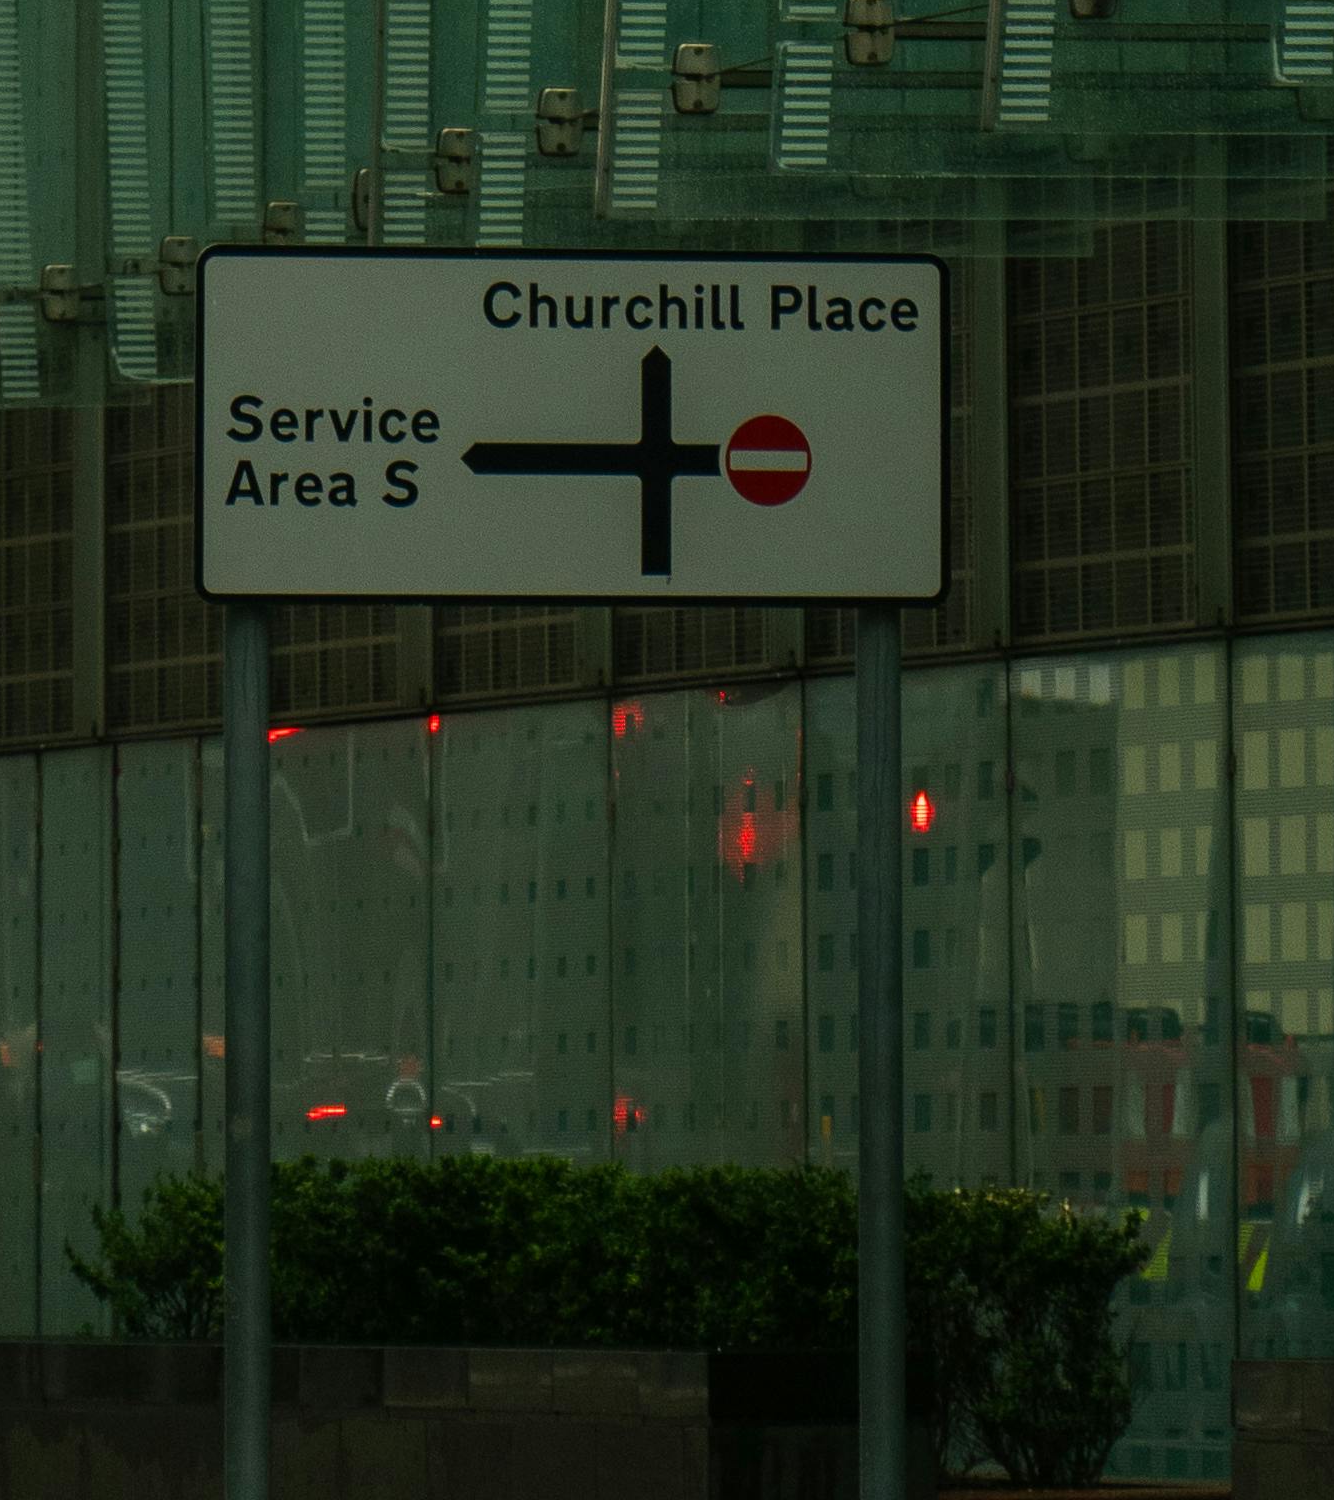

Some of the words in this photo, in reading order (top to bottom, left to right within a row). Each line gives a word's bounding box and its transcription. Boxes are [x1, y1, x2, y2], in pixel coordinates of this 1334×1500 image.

[483, 281, 745, 331] Churchill
[770, 284, 919, 333] Place
[226, 394, 441, 444] Service
[225, 459, 358, 507] Area
[381, 459, 419, 508] S
